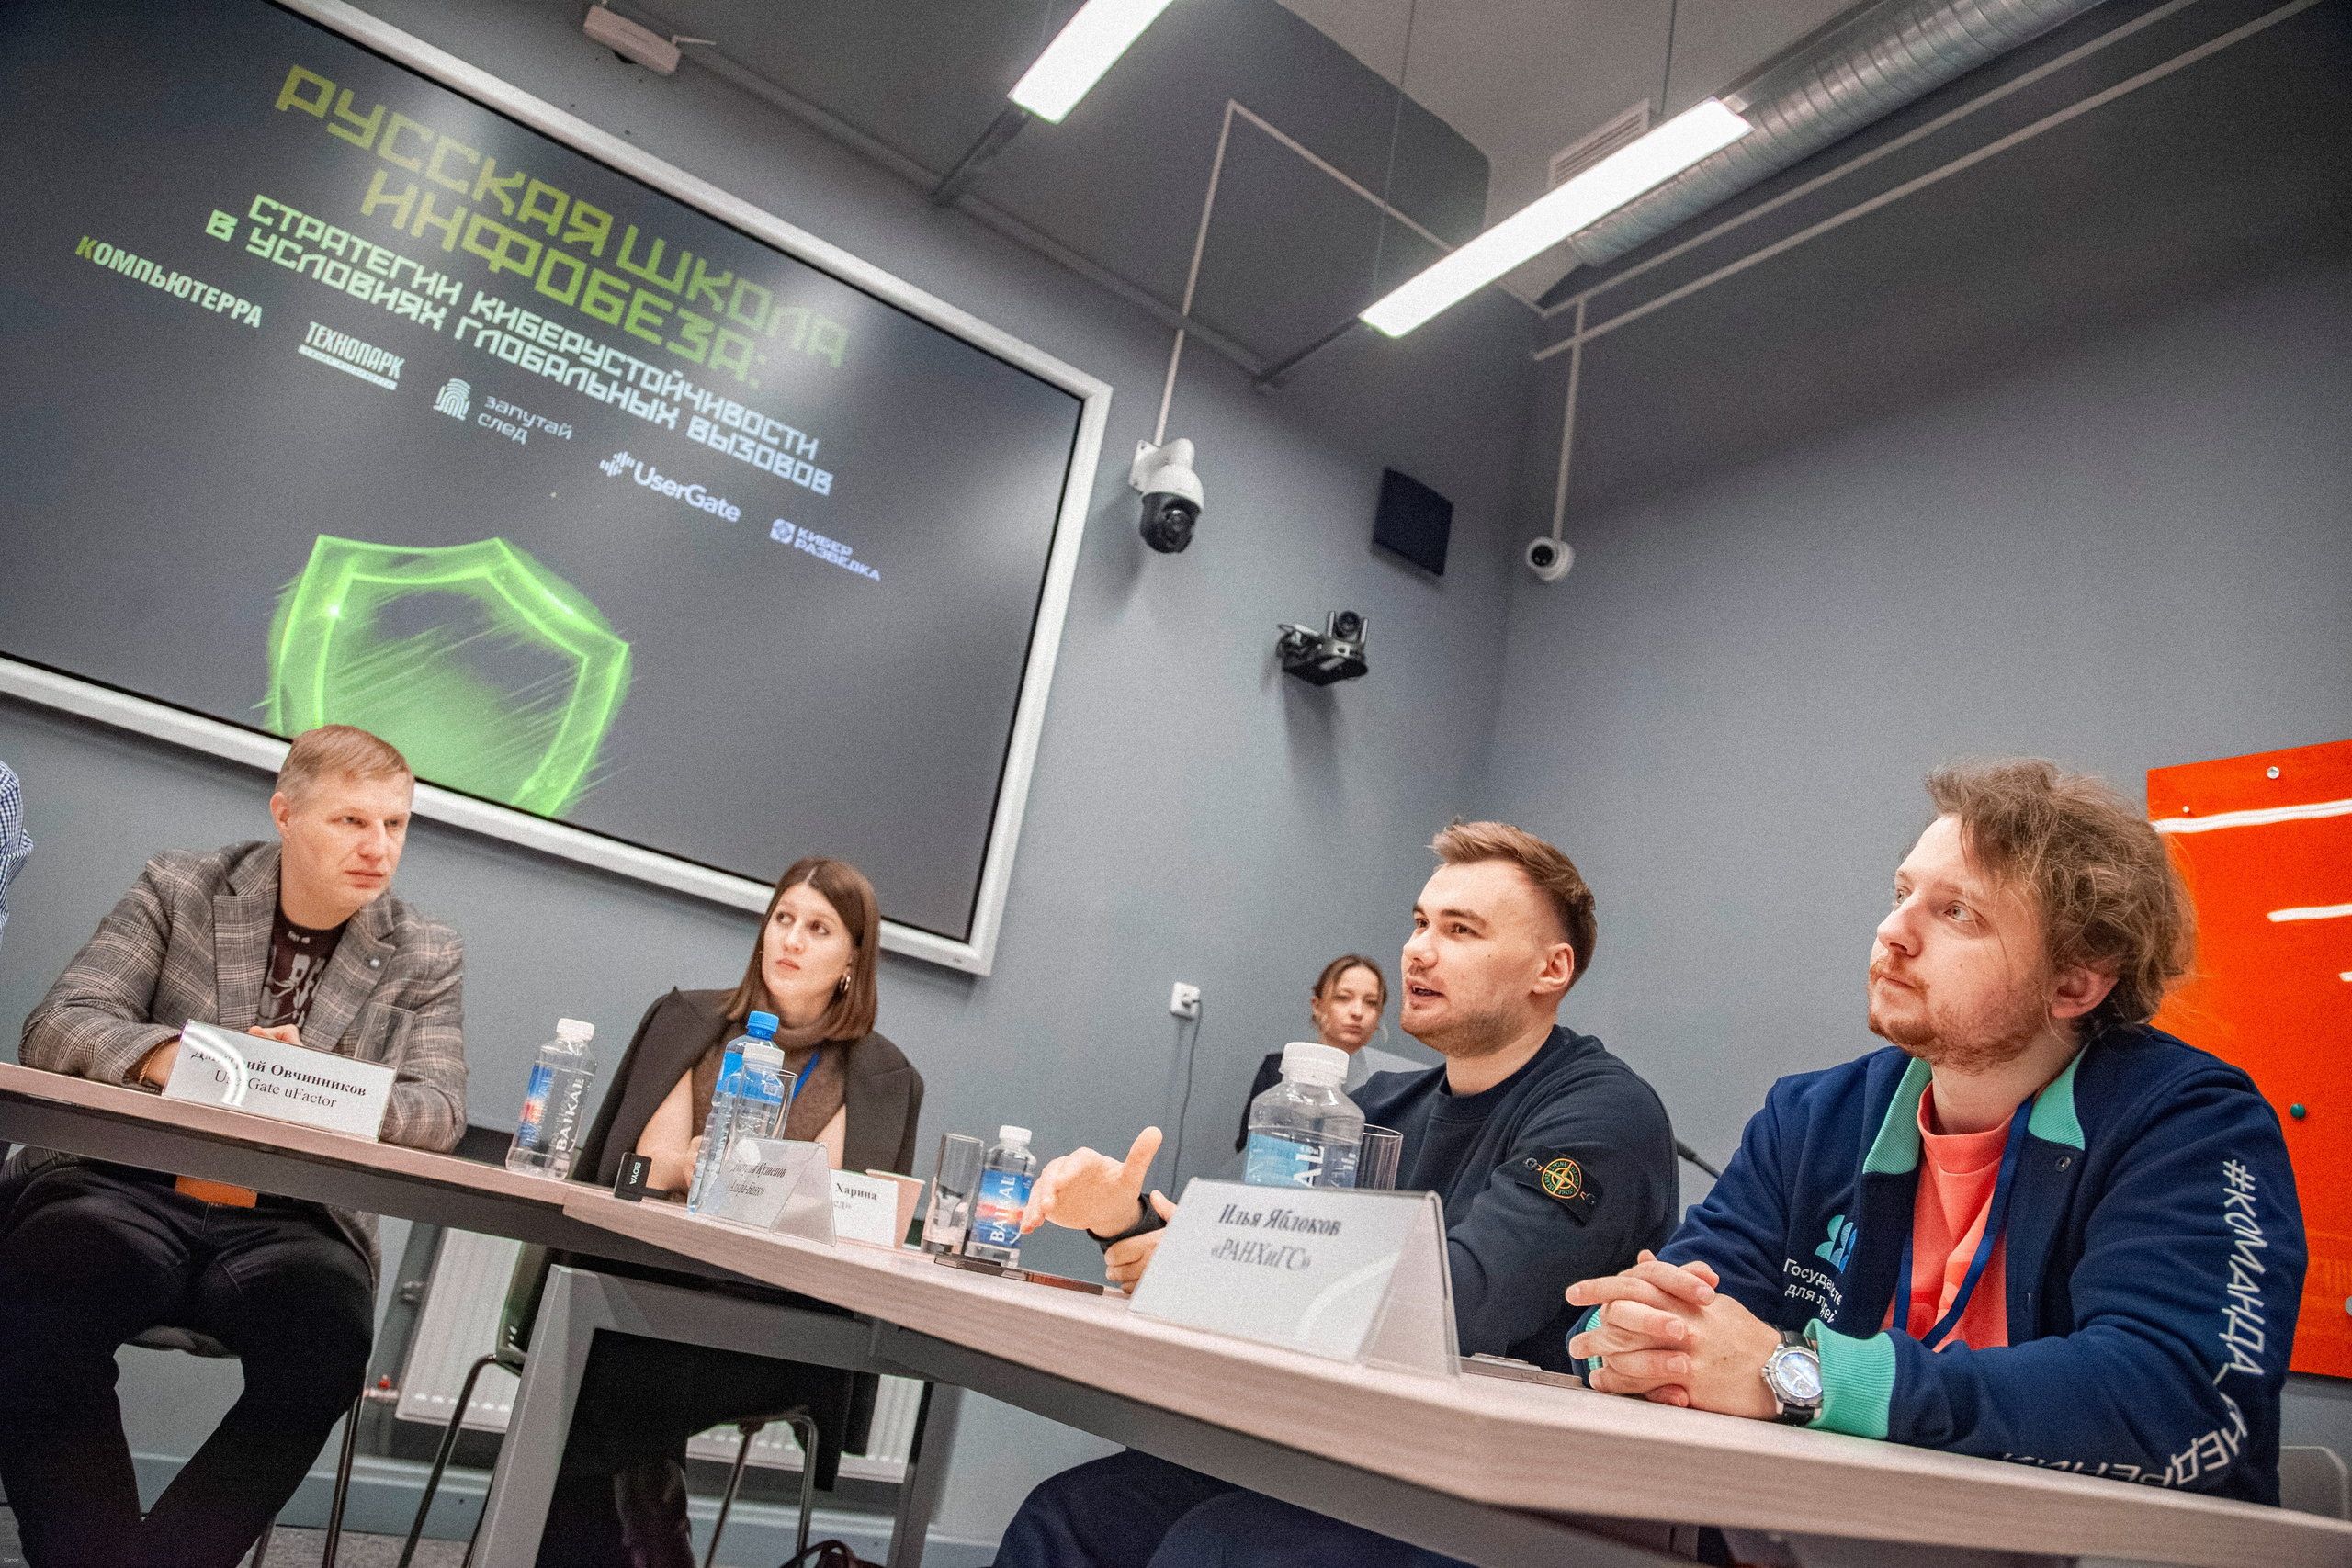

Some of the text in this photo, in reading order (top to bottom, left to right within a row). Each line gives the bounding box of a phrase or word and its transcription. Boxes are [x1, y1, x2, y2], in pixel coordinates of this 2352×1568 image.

[276, 63, 849, 368] РУССКАЯ ШКОЛА
[75, 235, 263, 328] КОМПЬЮТЕРРА
[360, 171, 769, 389] ИНФОБЕЗА:
[205, 209, 834, 496] В УСЛОВИЯХ ГЛОБАЛЬНЫХ ВЫЗОВОВ
[248, 194, 820, 461] СТРАТЕГИИ КИБЕРУСТОЙЧИВОСТИ
[304, 321, 405, 379] ТЕХНОПАРК
[477, 413, 528, 446] след
[483, 395, 572, 441] запутай
[633, 461, 741, 523] UserGate
[270, 1064, 367, 1097] Овчинников
[629, 1162, 642, 1185] BOYA
[836, 1183, 877, 1201] Харина
[1218, 1204, 1341, 1235] Илья Яблоков
[1784, 1284, 1815, 1301] для
